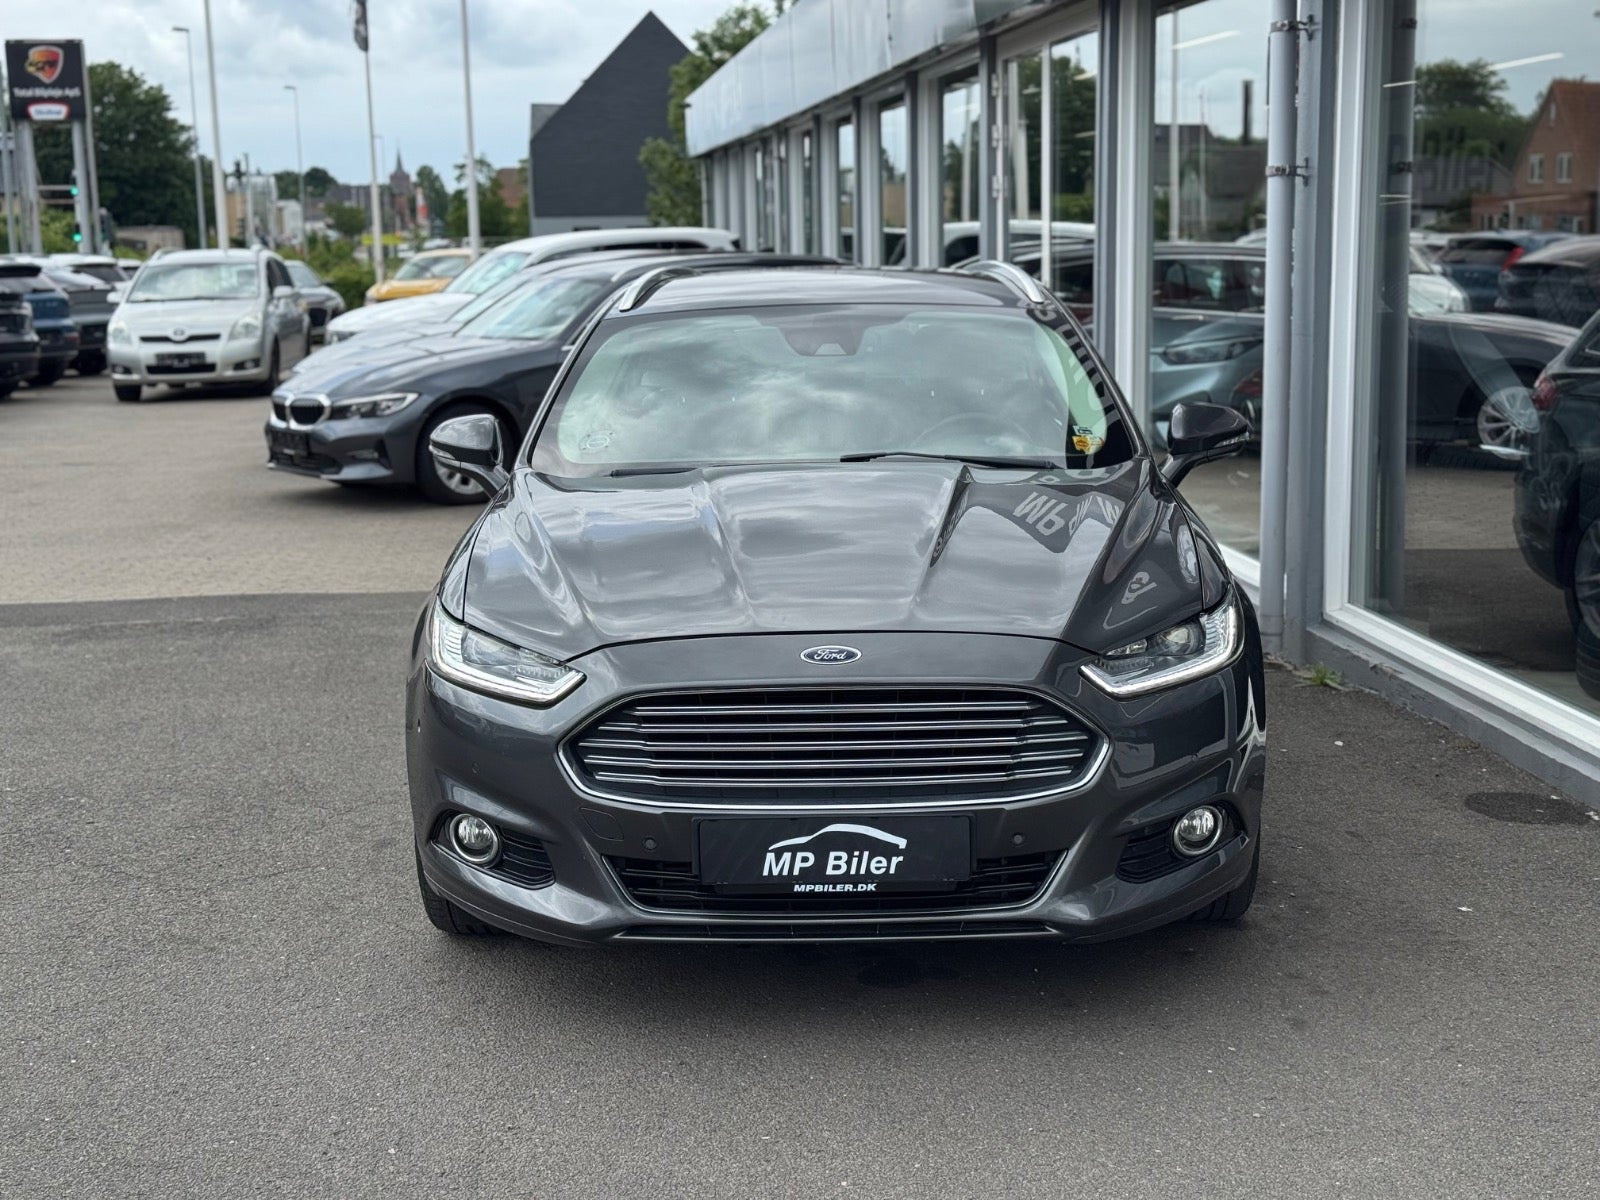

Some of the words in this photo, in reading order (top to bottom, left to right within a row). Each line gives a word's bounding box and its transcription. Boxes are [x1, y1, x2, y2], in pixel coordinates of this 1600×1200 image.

[814, 649, 847, 660] Ford
[762, 851, 815, 876] MP
[826, 850, 904, 875] Biler
[793, 883, 877, 892] MPBILER.DK
